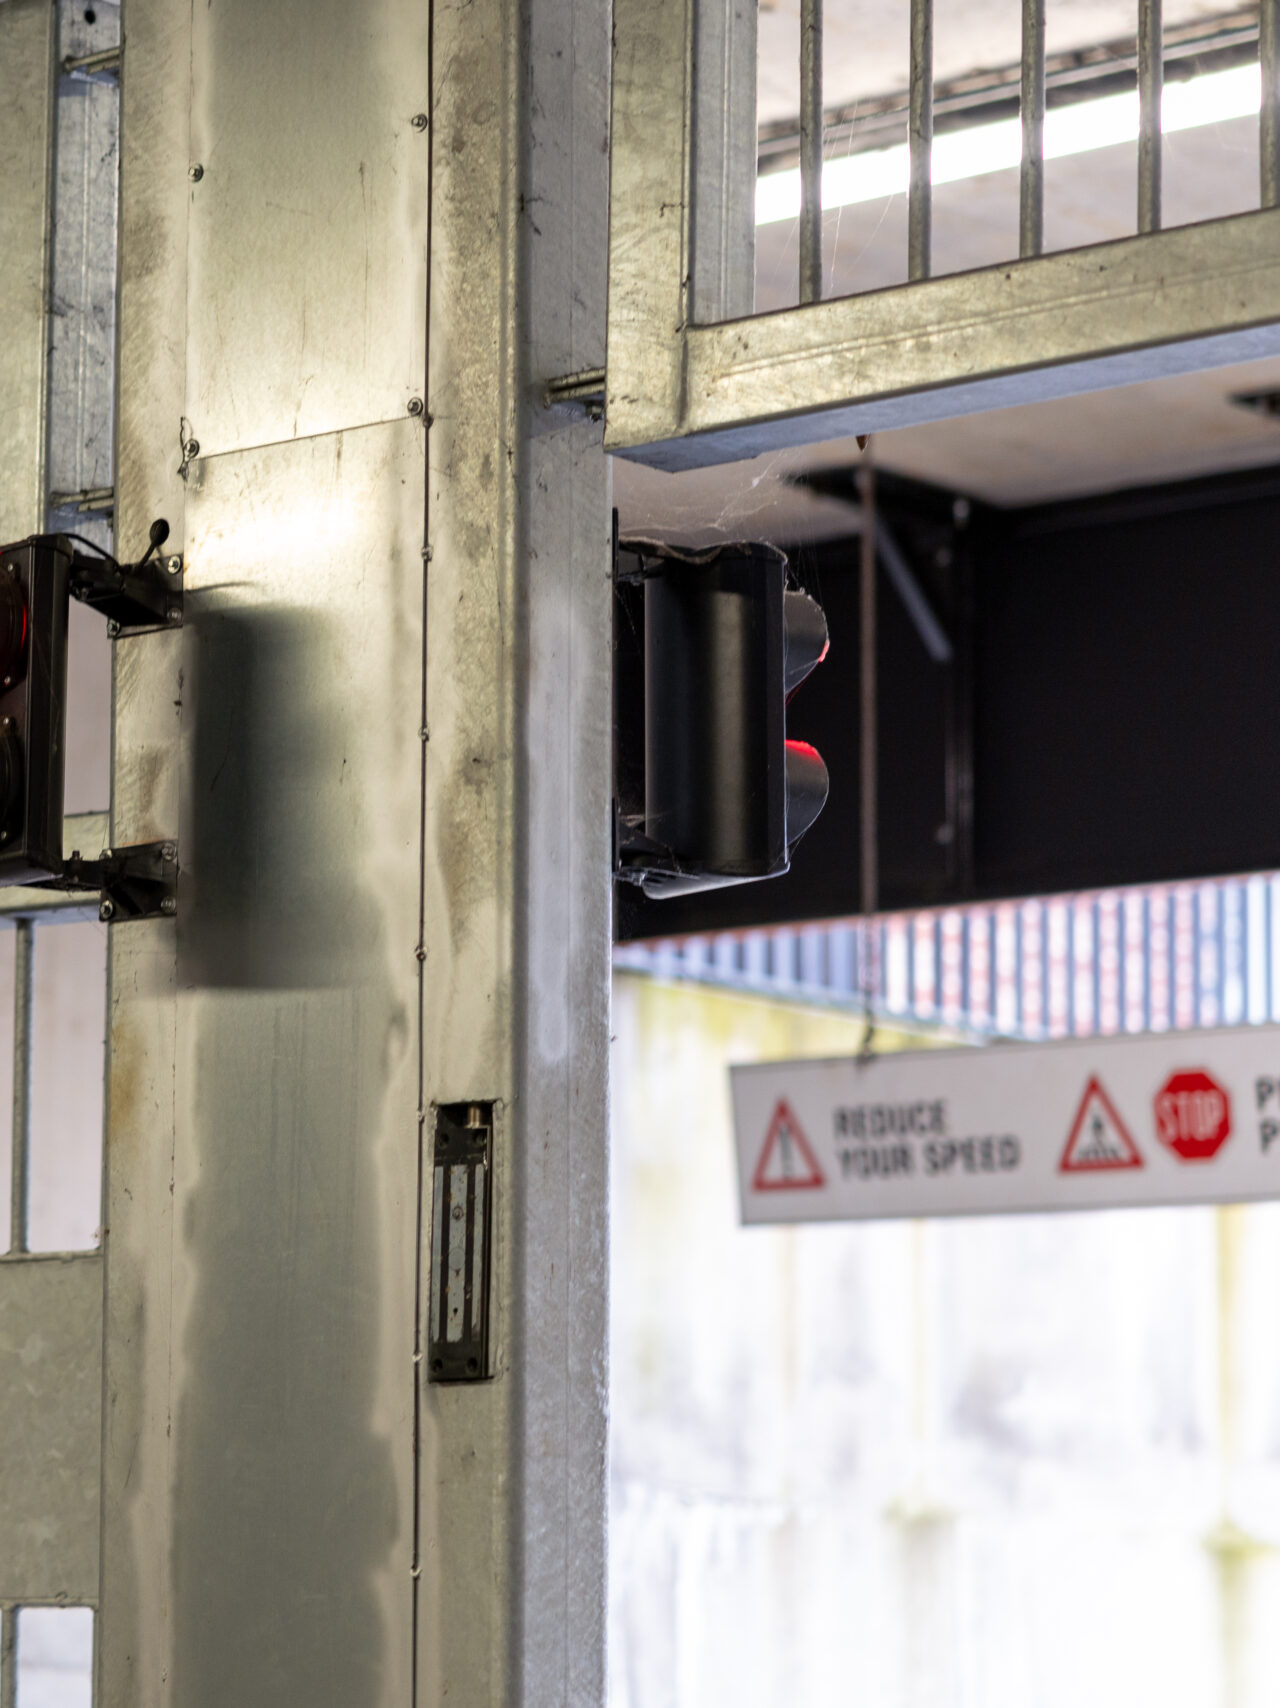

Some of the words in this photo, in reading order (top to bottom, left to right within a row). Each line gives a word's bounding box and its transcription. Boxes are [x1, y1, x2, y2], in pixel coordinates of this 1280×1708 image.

[833, 1100, 948, 1140] REDUCE
[1155, 1091, 1225, 1142] STOP
[836, 1143, 913, 1181] YOUR
[923, 1135, 1021, 1177] SPEED
